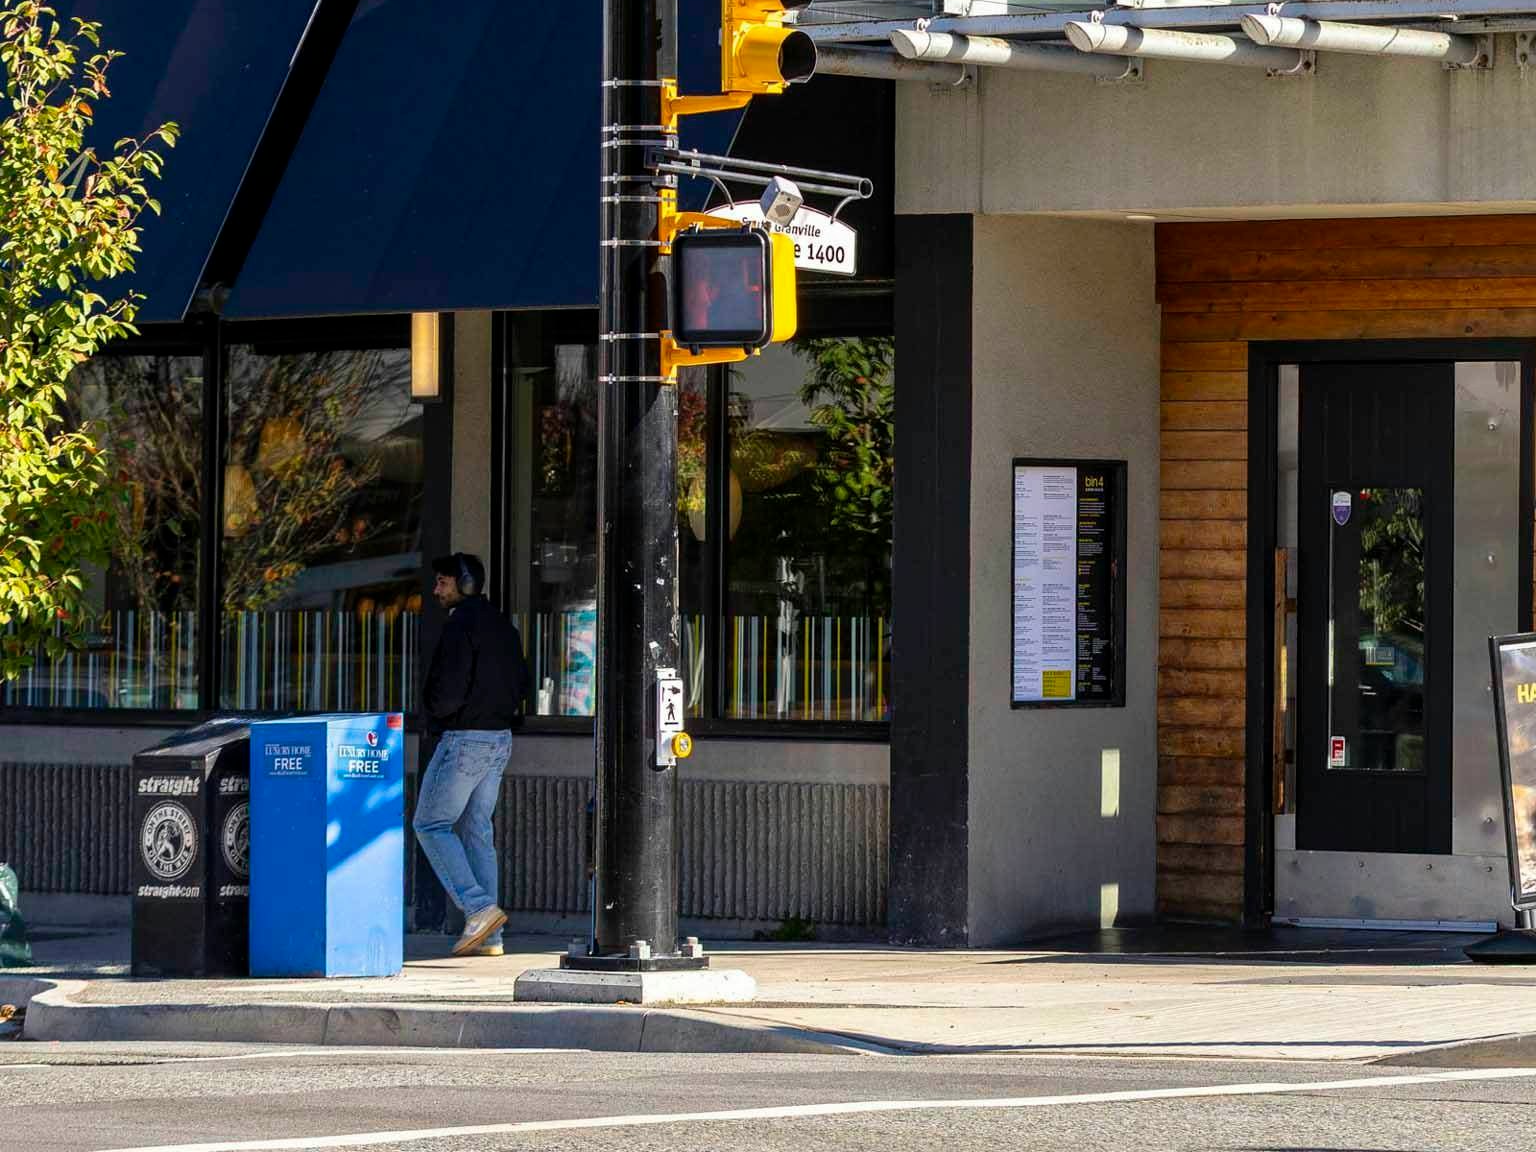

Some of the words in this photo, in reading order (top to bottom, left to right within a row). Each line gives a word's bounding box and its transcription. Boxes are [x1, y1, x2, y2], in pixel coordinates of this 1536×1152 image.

[807, 243, 845, 264] 1400
[274, 757, 303, 771] FREE
[348, 760, 379, 774] FREE
[138, 776, 200, 796] straight
[169, 809, 191, 834] STREET
